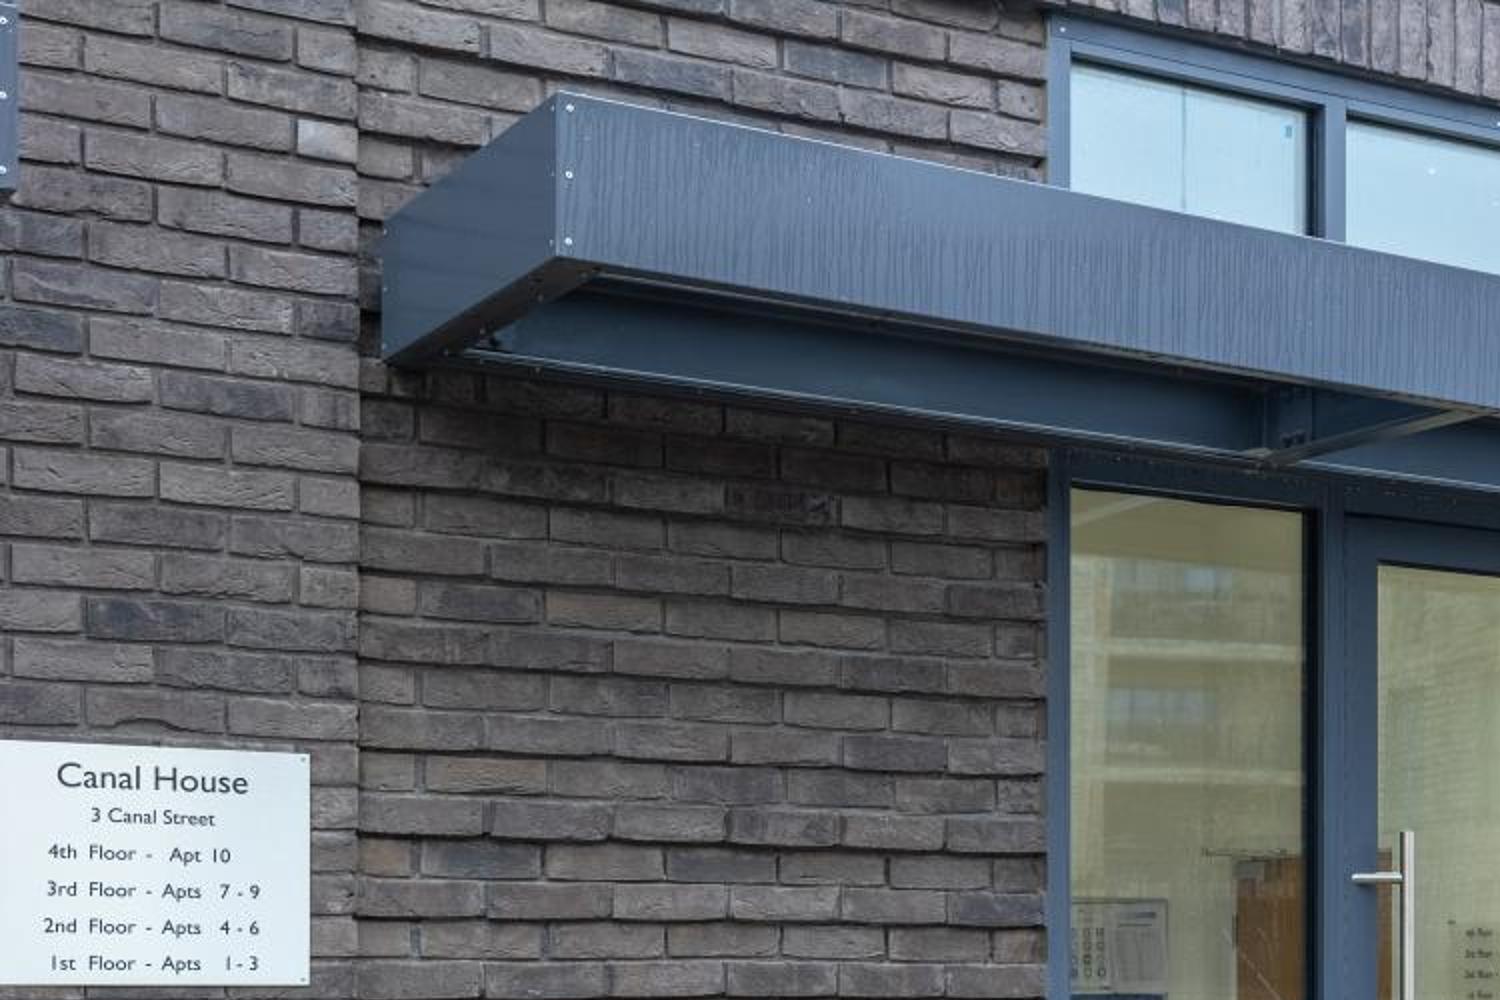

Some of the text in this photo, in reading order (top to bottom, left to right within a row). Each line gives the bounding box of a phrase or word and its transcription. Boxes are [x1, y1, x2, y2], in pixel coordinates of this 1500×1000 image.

[57, 762, 249, 795] Canal House
[91, 807, 216, 827] 3 Canal Street
[48, 844, 77, 859] 4th
[89, 844, 136, 861] Floor
[169, 847, 202, 866] Apt
[213, 848, 231, 864] 10
[47, 880, 77, 897] 3rd
[89, 881, 137, 897] Floor
[161, 883, 202, 902] Apts
[220, 883, 230, 899] 7
[249, 884, 260, 899] 9
[44, 917, 77, 934] 2nd
[89, 918, 137, 935] Floor
[161, 919, 201, 938] Apts
[219, 920, 231, 935] 4
[249, 920, 260, 935] 6
[51, 955, 76, 971] 1st
[89, 955, 136, 971] Floor
[161, 955, 201, 975] Apts
[226, 956, 231, 971] 1
[249, 955, 259, 971] 3
